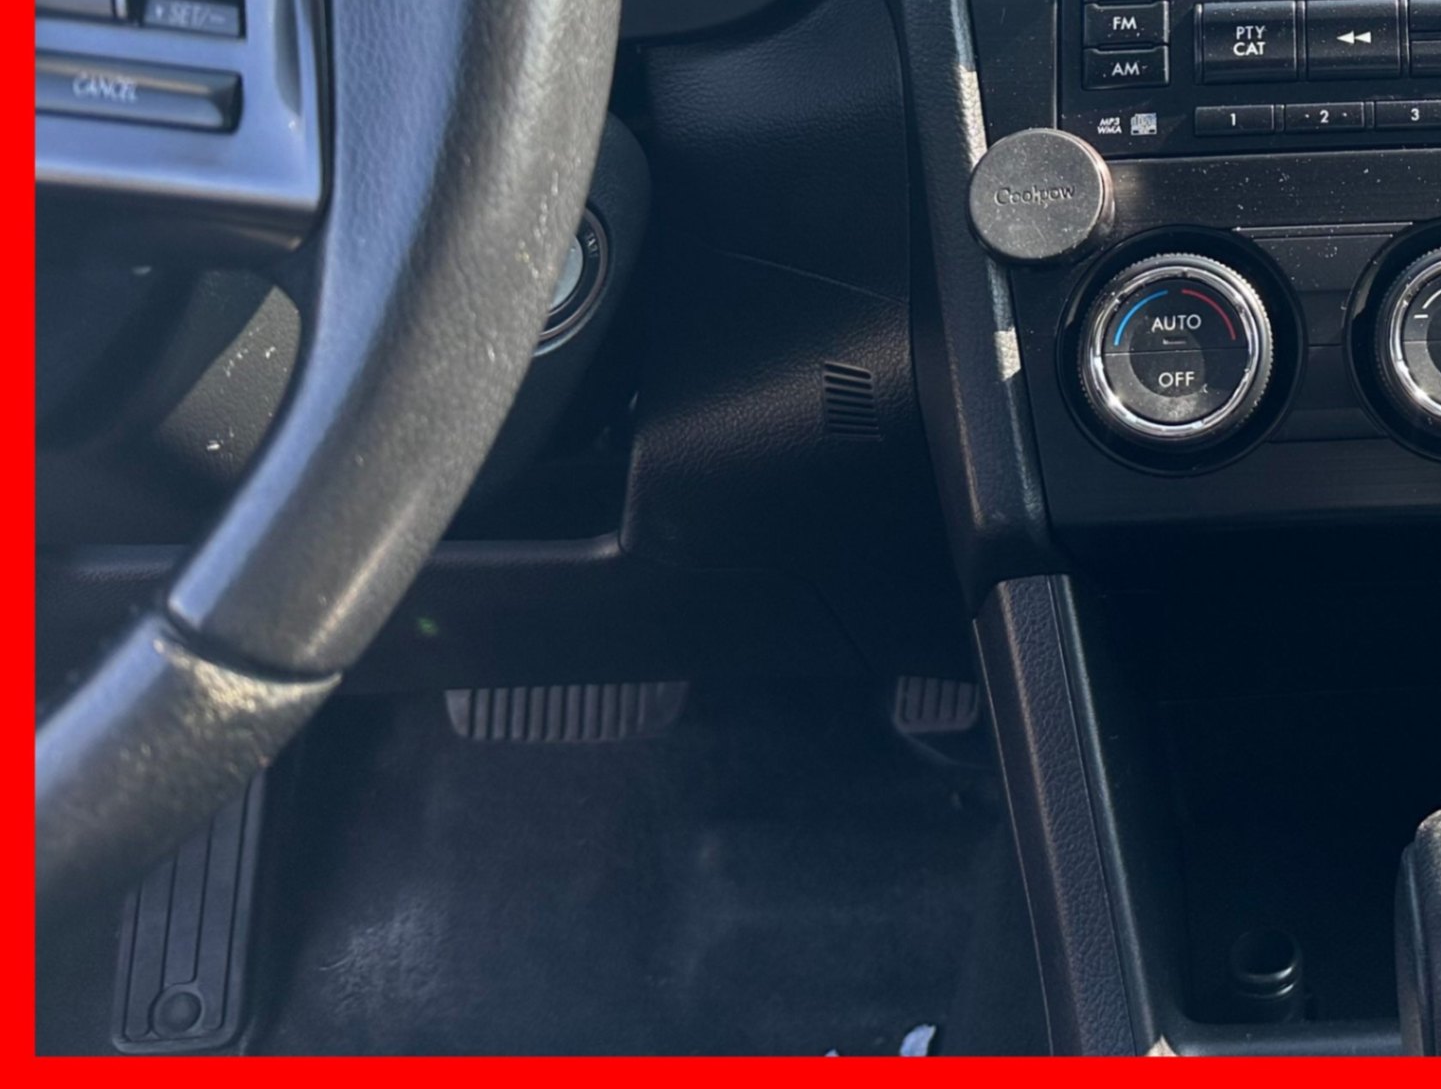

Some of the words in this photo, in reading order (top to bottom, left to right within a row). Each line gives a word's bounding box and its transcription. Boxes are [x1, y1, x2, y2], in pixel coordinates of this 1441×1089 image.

[1113, 16, 1137, 30] FM
[1236, 25, 1266, 40] PTY
[1233, 42, 1265, 56] CAT
[1112, 61, 1140, 76] AM
[73, 75, 137, 102] CANCEL
[1099, 116, 1120, 126] MP3
[1230, 113, 1236, 126] 1
[1320, 109, 1329, 123] 2
[1411, 108, 1420, 121] 3
[1097, 125, 1122, 135] WMA
[1151, 314, 1201, 333] AUTO
[1158, 371, 1194, 389] OFF
